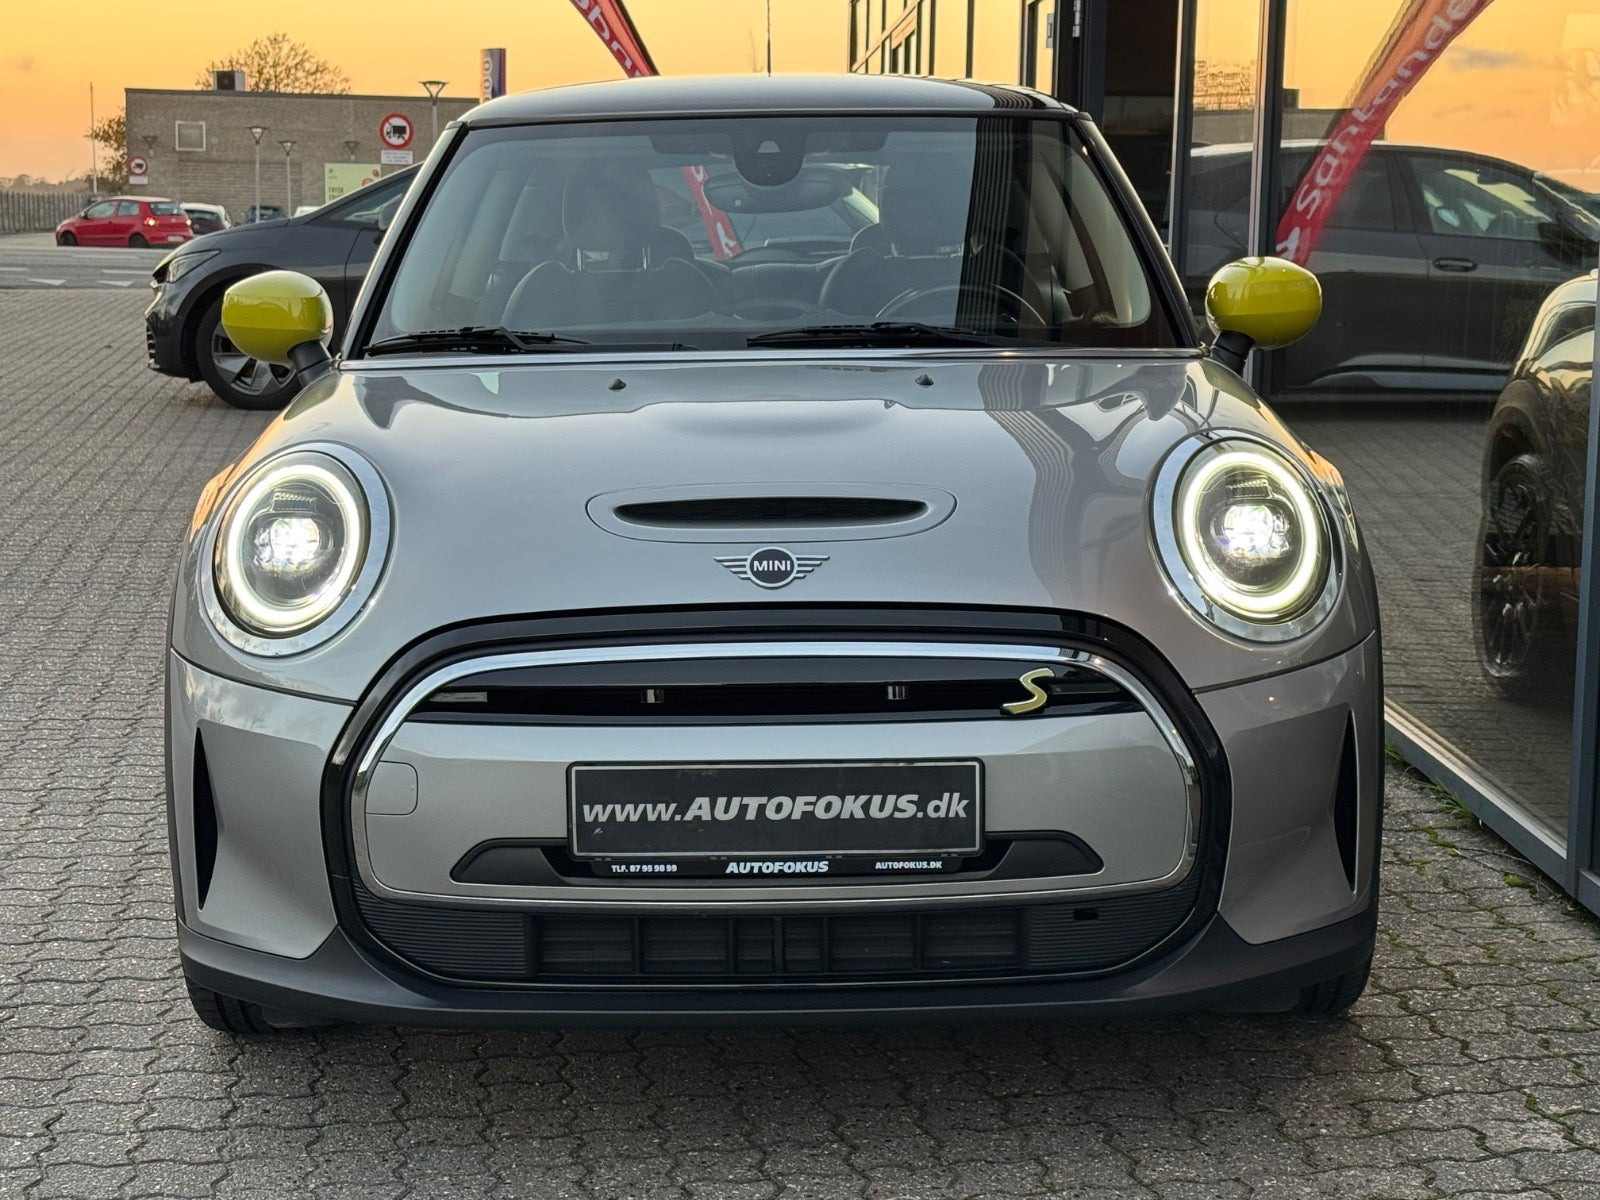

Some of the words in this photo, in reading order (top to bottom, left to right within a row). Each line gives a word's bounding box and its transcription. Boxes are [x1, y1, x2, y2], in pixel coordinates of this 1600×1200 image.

[753, 560, 791, 572] MINI
[1003, 667, 1055, 715] S
[582, 792, 970, 823] www.AUTOFOKUS.dk
[611, 864, 629, 873] TLF.
[725, 861, 829, 874] AUTOFOKUS
[875, 861, 942, 869] AUTOFOKUS.DK
